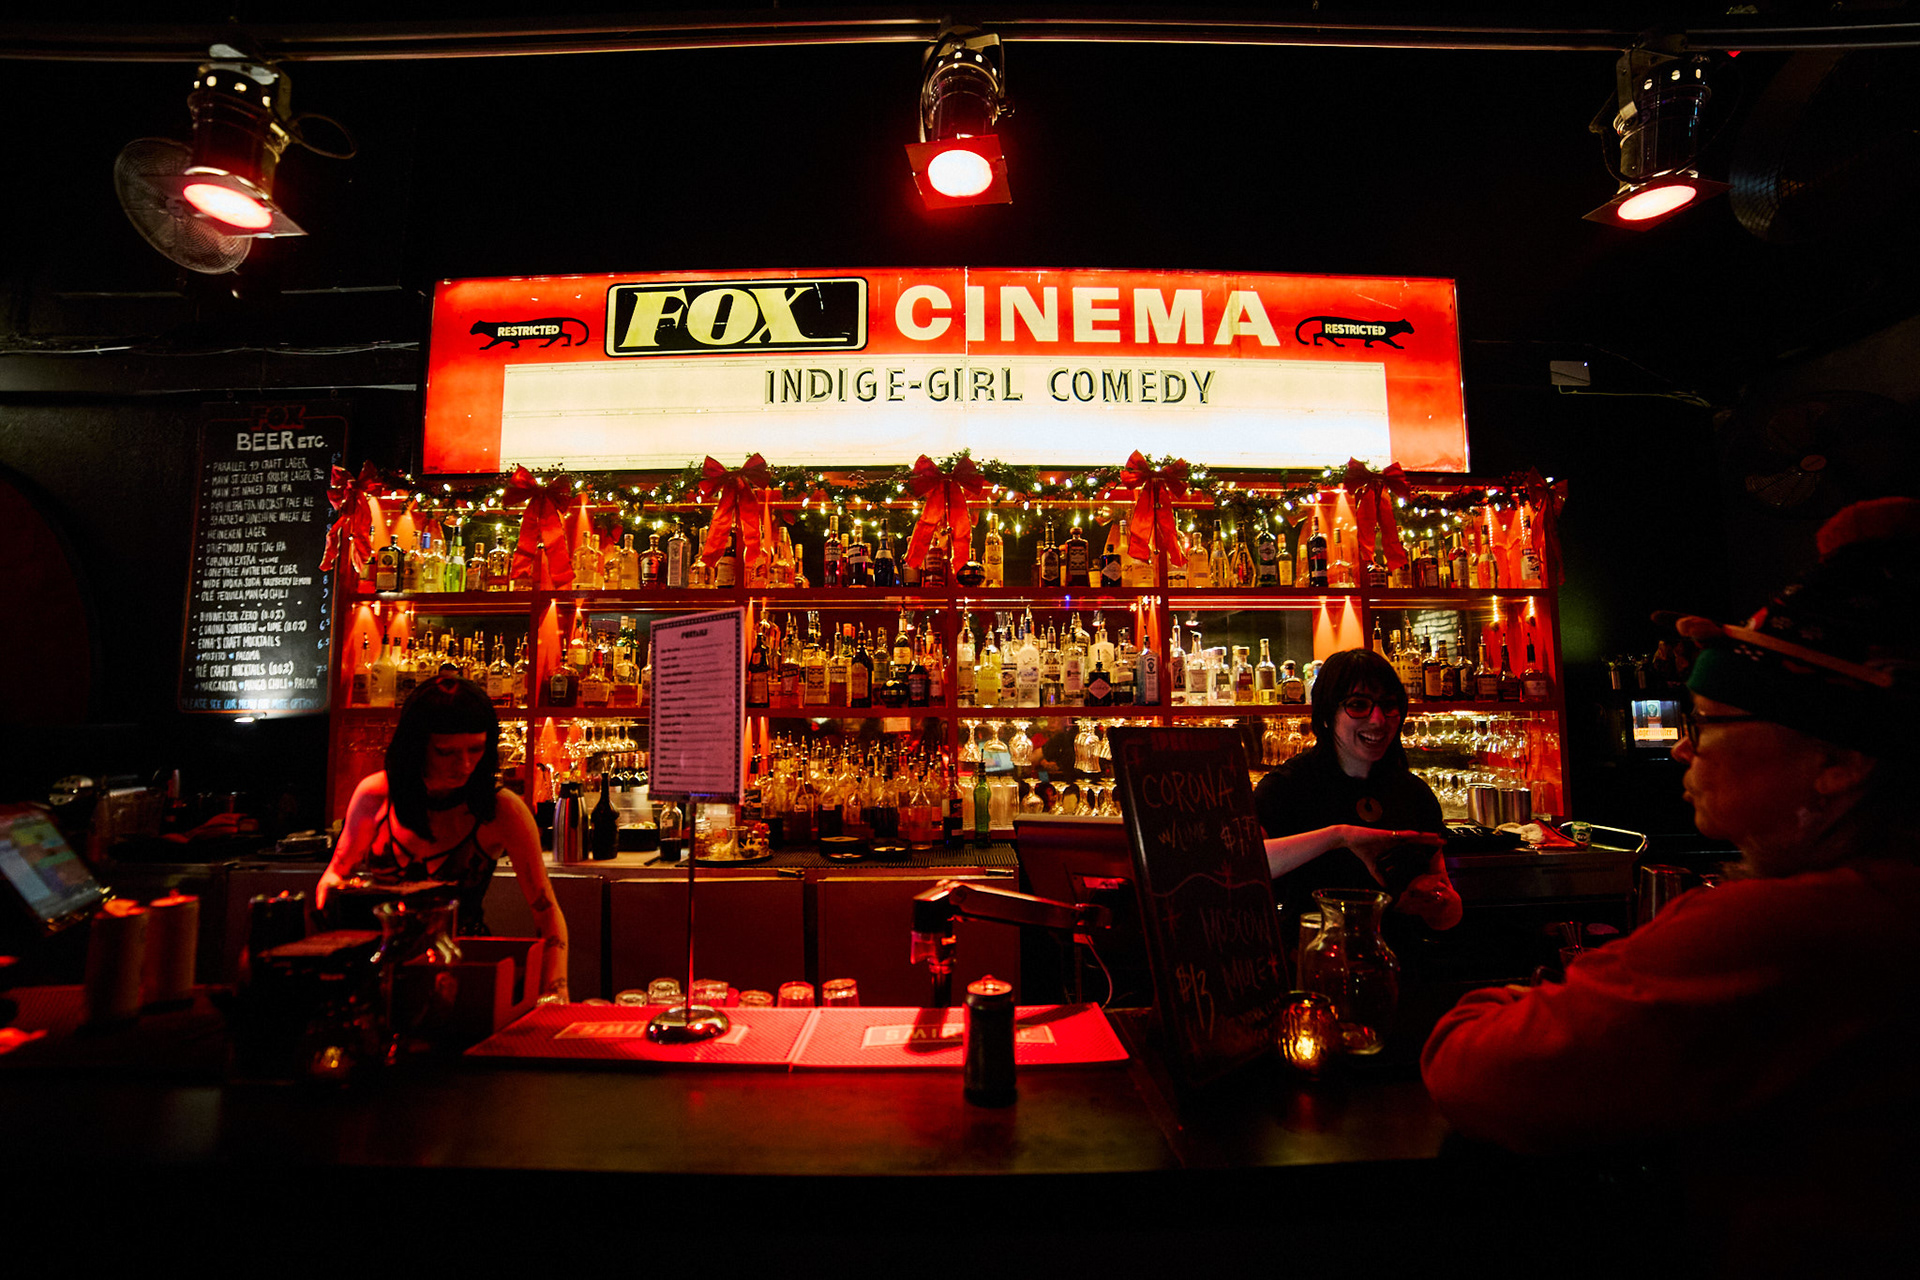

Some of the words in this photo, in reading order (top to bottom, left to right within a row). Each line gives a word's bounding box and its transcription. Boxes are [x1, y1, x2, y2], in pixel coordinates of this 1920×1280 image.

[619, 286, 848, 347] FOX
[894, 284, 1280, 347] CINEMA
[497, 323, 560, 337] RESTRICTED
[1324, 321, 1387, 337] RESTRICTED
[1050, 367, 1216, 404] COMEDY
[236, 430, 296, 452] BEER
[297, 434, 328, 449] ETC.
[261, 458, 284, 469] CRAFT
[285, 456, 309, 469] LAGER
[303, 497, 314, 508] ALE
[244, 526, 267, 538] LAGER
[240, 610, 259, 621] ZERO
[1142, 763, 1236, 813] CORONA
[1199, 904, 1273, 954] MOSCOW
[1220, 955, 1267, 1001] MULE
